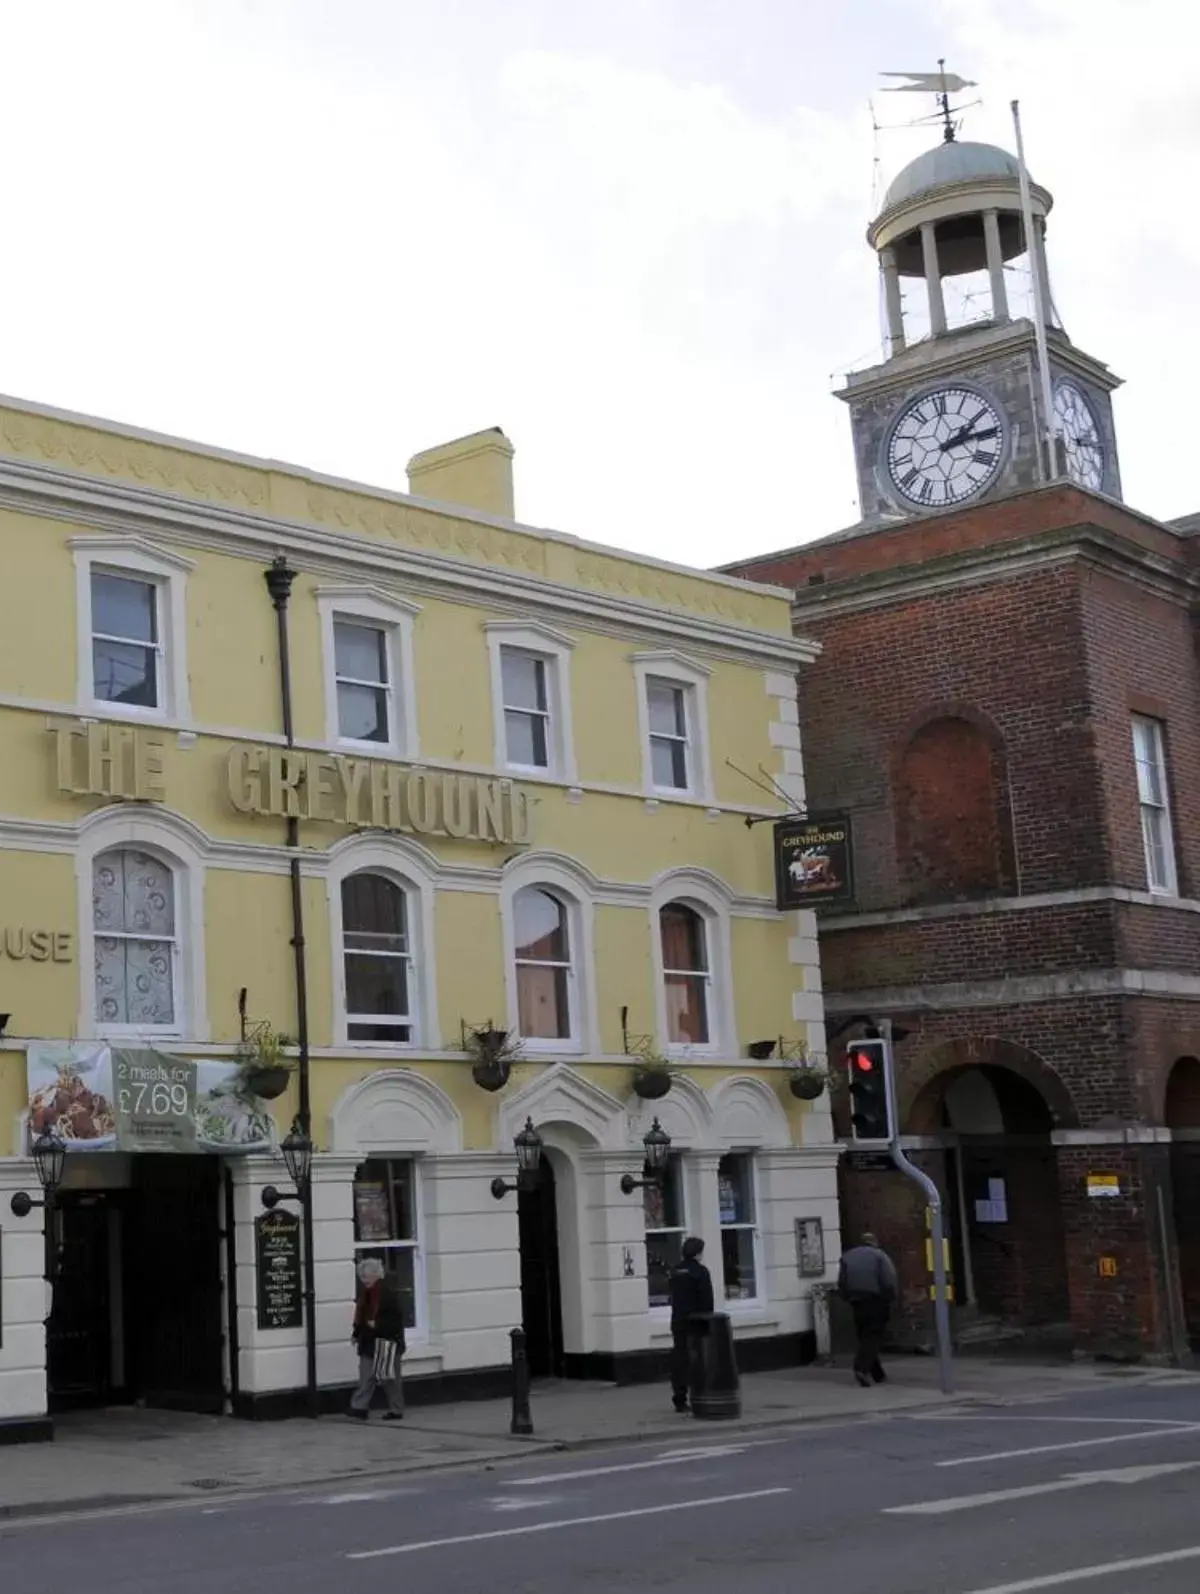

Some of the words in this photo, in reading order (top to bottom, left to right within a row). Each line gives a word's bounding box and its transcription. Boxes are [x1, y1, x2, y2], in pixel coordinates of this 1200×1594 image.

[46, 722, 164, 802] THE
[228, 742, 532, 846] GREYHOUND
[783, 831, 845, 848] GREYHOUND
[118, 1063, 128, 1079] 2
[130, 1064, 168, 1081] meals
[171, 1066, 192, 1082] for
[119, 1082, 188, 1116] £7.69
